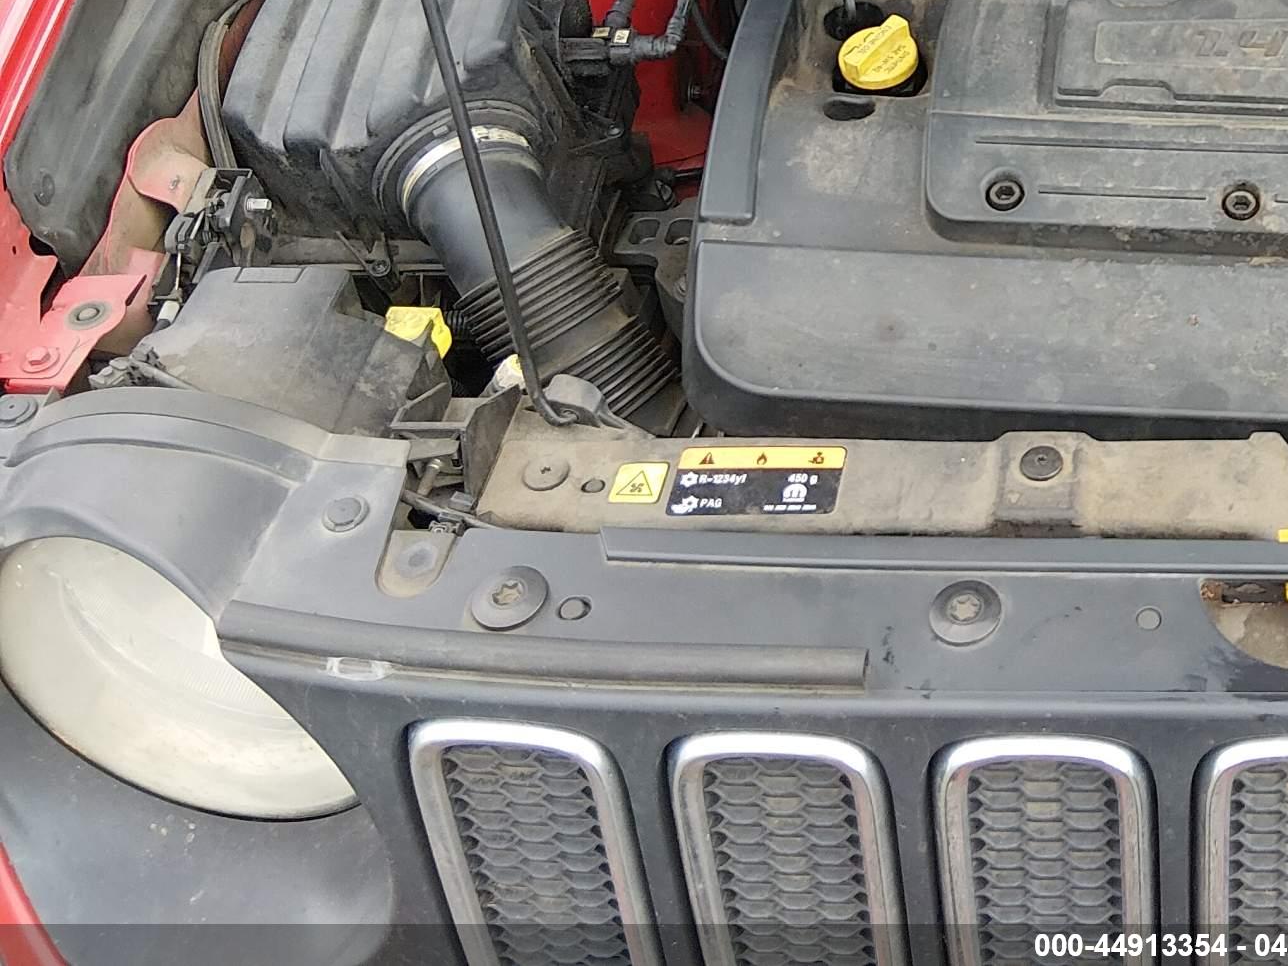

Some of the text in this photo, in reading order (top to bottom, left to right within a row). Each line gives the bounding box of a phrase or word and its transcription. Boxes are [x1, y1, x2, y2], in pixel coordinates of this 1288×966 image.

[787, 473, 819, 485] 450 g
[699, 498, 723, 509] PAG
